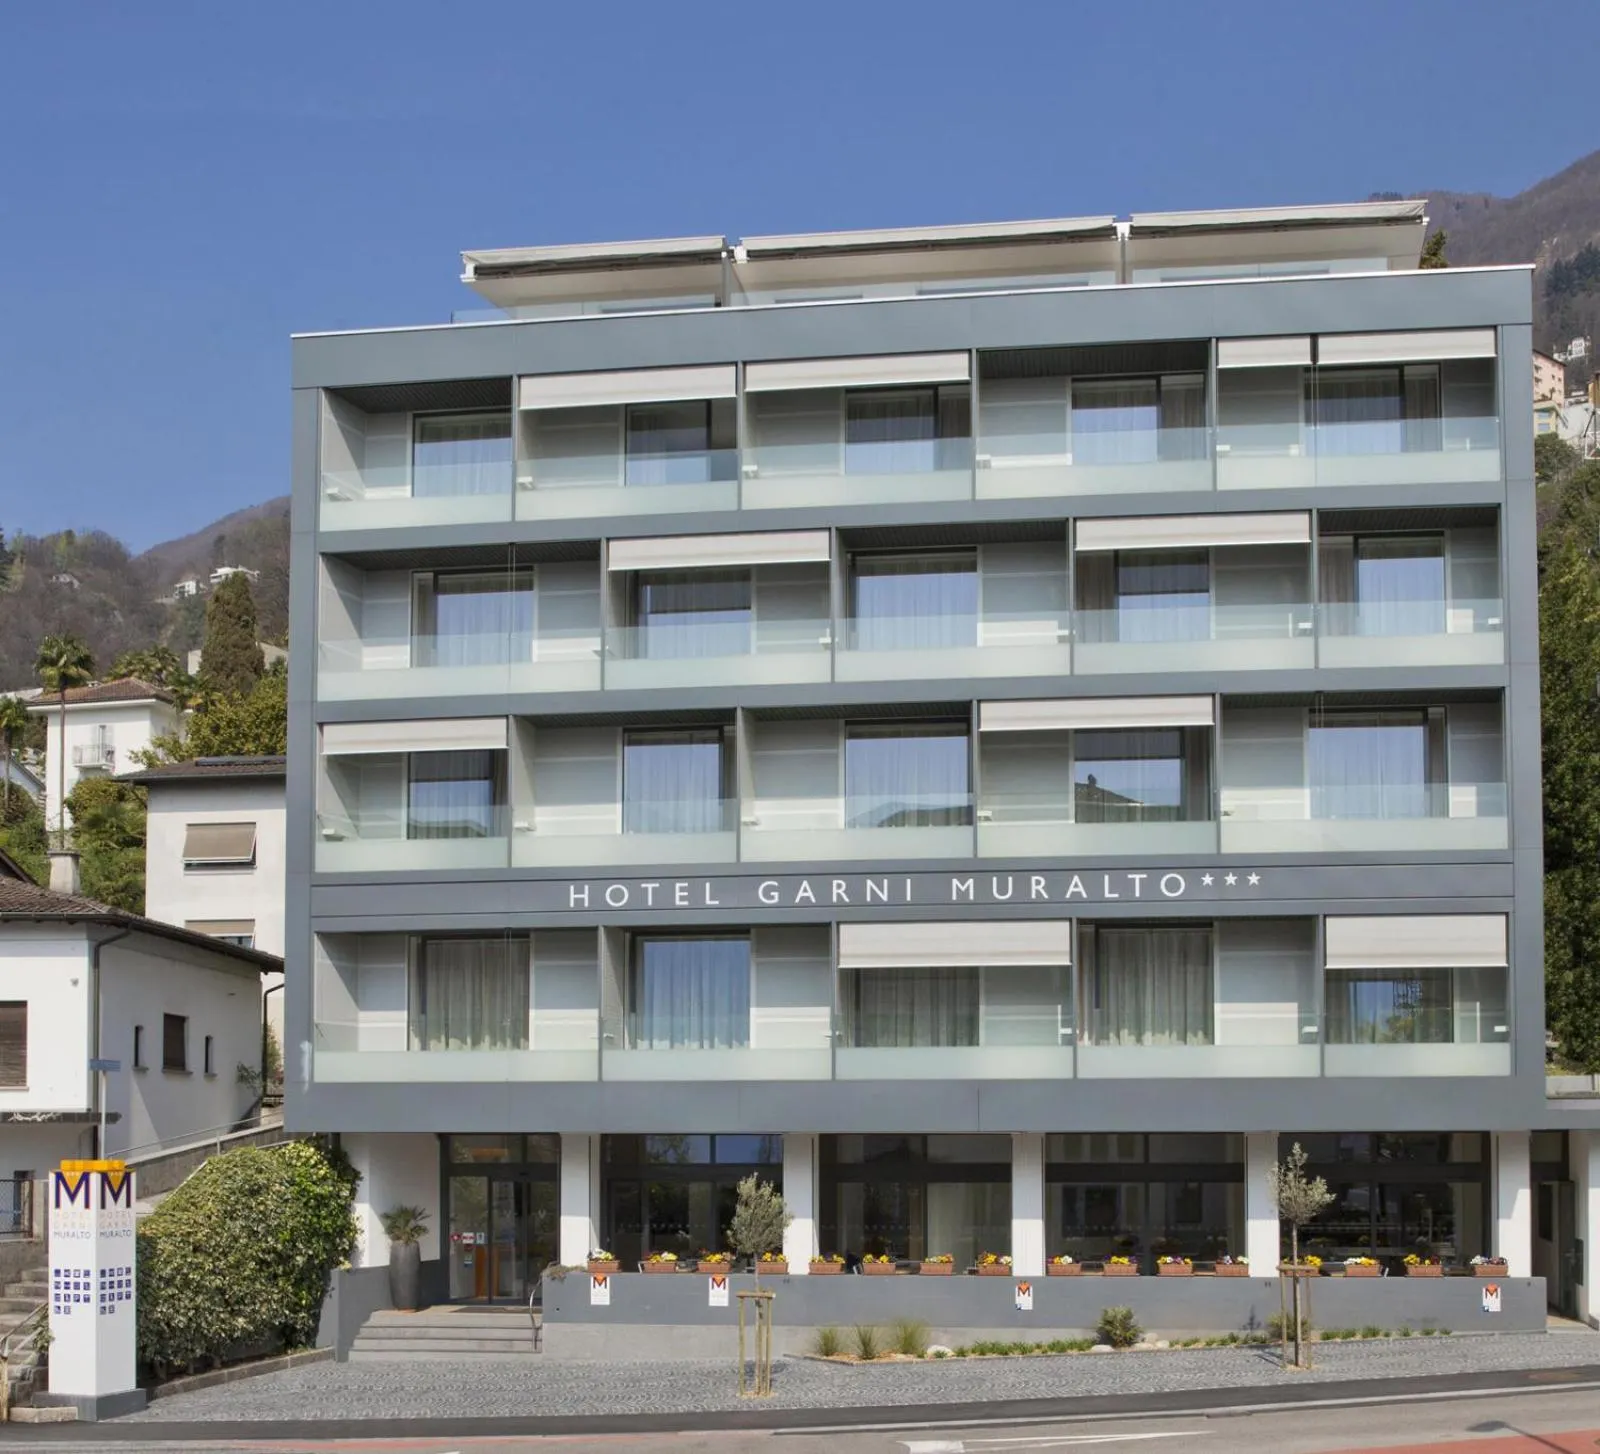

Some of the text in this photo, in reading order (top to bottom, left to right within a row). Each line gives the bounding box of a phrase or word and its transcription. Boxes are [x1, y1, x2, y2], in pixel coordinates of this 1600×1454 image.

[568, 873, 1186, 908] HOTEL GARNI MURALTO
[55, 1171, 90, 1209] M
[100, 1171, 131, 1209] M
[53, 1230, 91, 1239] MURALTO
[100, 1229, 132, 1238] MURALTO
[593, 1276, 607, 1289] M
[712, 1277, 726, 1290] M
